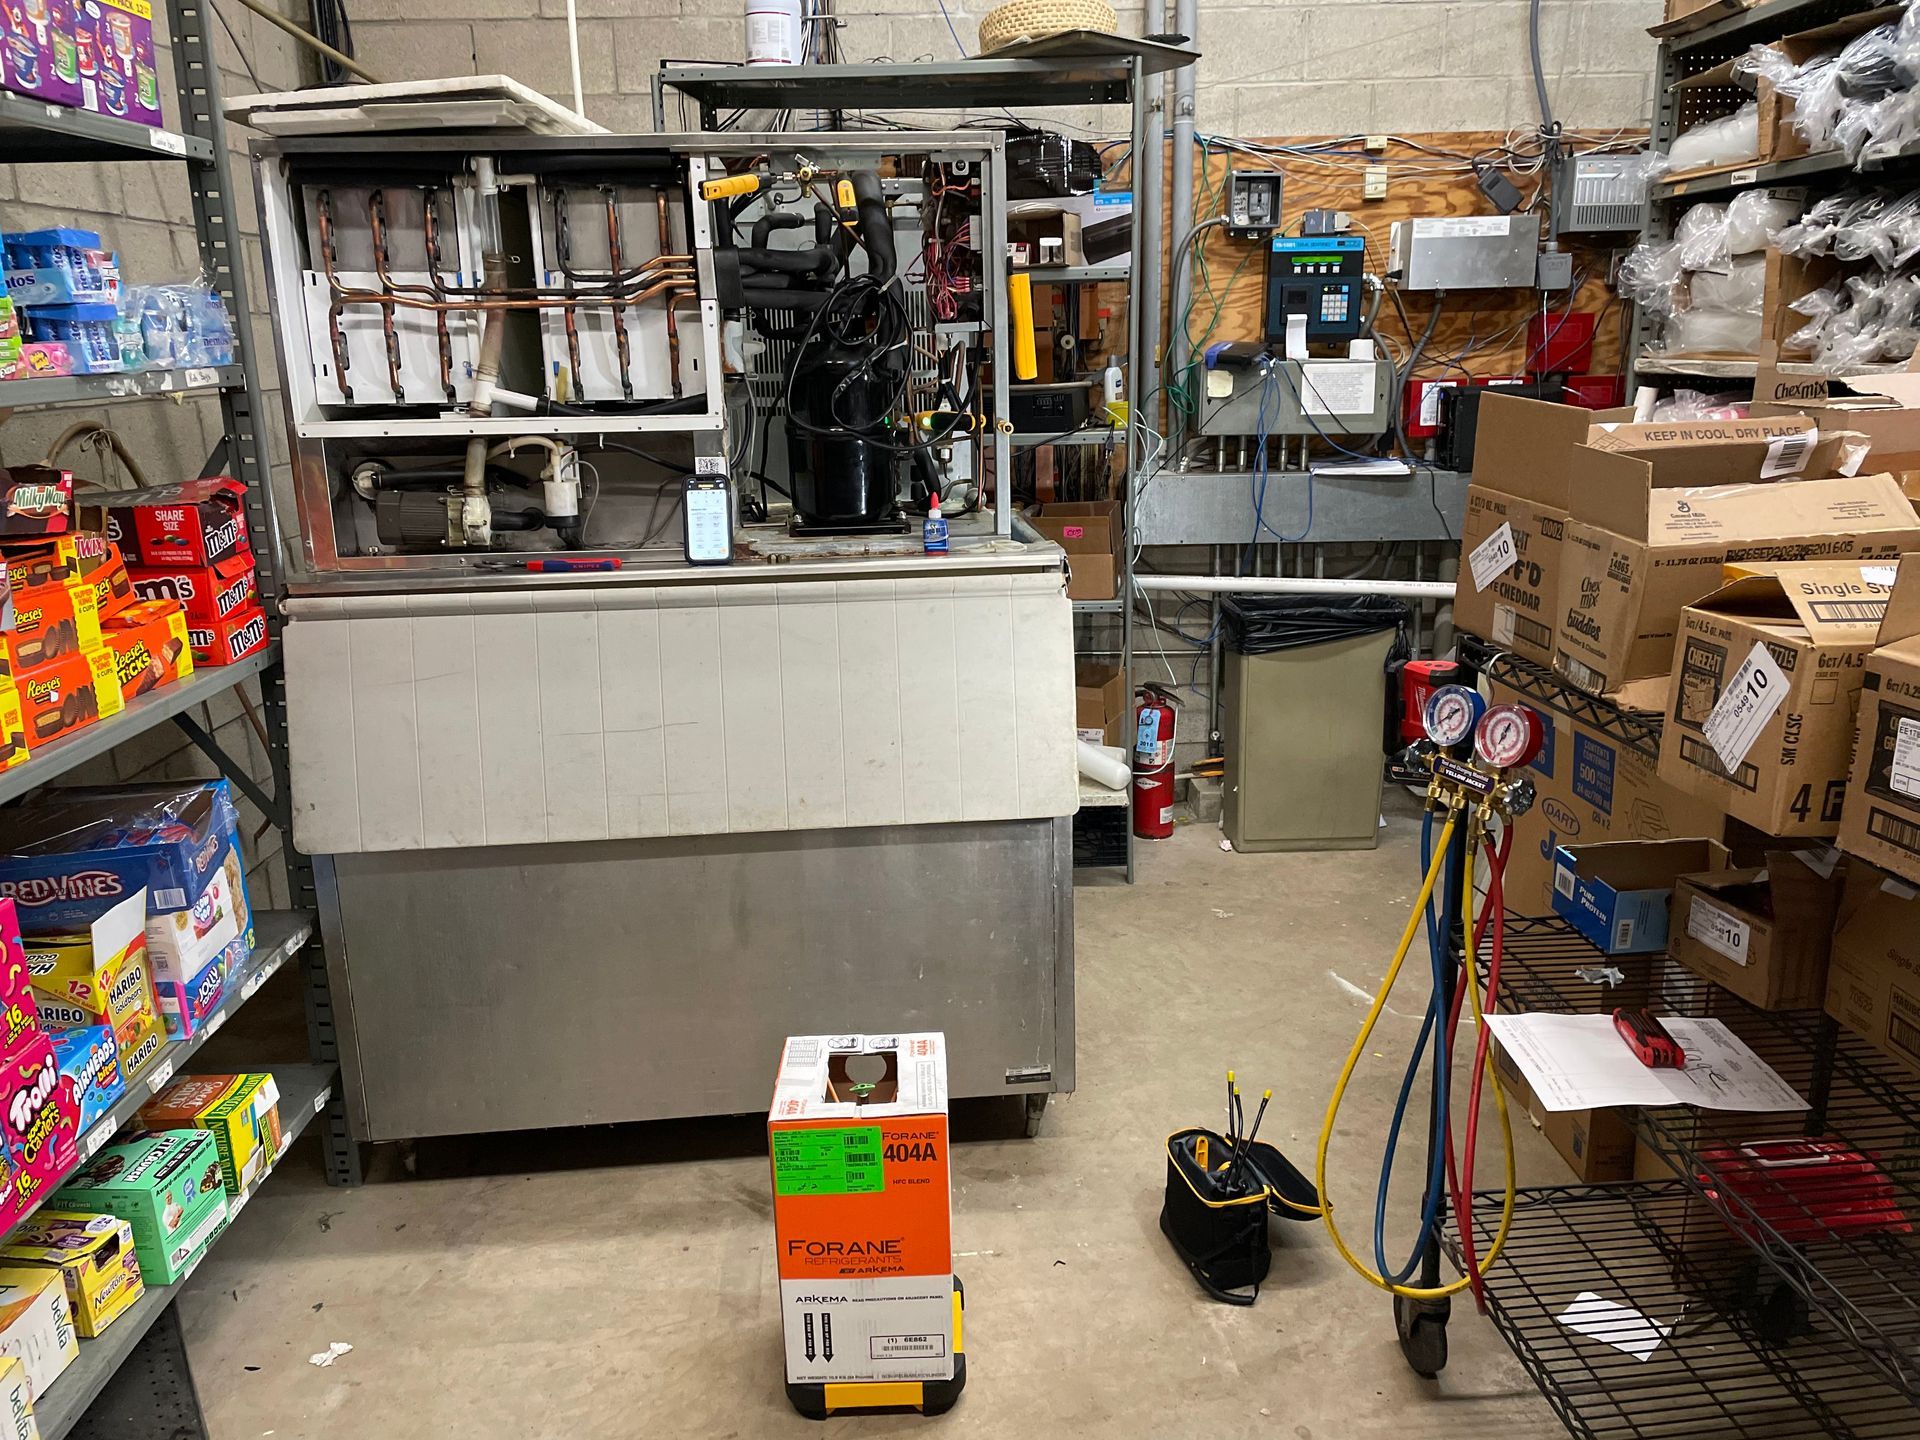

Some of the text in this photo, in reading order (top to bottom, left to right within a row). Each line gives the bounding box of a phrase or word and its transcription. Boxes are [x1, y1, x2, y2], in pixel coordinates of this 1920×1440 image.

[1775, 382, 1800, 400] Chex
[1645, 426, 1802, 442] KEEP IN COOL, DRY PLACE
[155, 510, 185, 521] SHARE
[163, 521, 180, 531] SIZE
[1497, 540, 1509, 558] 10
[1609, 559, 1630, 574] 14865
[74, 588, 94, 599] SUPER
[1500, 582, 1541, 612] CHEDDAR
[1800, 583, 1861, 597] Single
[77, 596, 94, 606] KING
[83, 604, 95, 613] CUPS
[1567, 608, 1601, 642] buddies
[91, 651, 112, 665] SUPER
[96, 660, 111, 671] KING
[101, 668, 114, 678] CUPS
[26, 676, 61, 699] Reese's
[1747, 669, 1768, 699] 10
[1445, 769, 1486, 789] YELLOW JACKET
[1579, 765, 1596, 785] 500
[1790, 784, 1812, 822] 4
[1545, 804, 1576, 830] DART
[1579, 886, 1596, 902] PURE
[1581, 897, 1607, 922] PROTEIN
[1725, 928, 1741, 948] 10
[69, 979, 92, 1000] 12
[99, 970, 110, 991] 12
[108, 966, 142, 1005] HARIBO
[199, 966, 219, 999] JOLLY
[81, 1002, 97, 1011] BAGS
[115, 985, 143, 1015] Goldbears
[6, 1003, 23, 1026] 16
[36, 1007, 85, 1022] ARIBO
[126, 1033, 158, 1075] HARIBO
[73, 1037, 115, 1106] AIRHEADS
[97, 1059, 117, 1083] bites
[10, 1054, 57, 1132] Trolli
[24, 1108, 60, 1164] Crawlers
[208, 1121, 229, 1156] NATURE
[882, 1131, 937, 1141] FORANE
[883, 1142, 937, 1163] 404A
[15, 1169, 32, 1193] 16
[155, 1162, 191, 1197] Award-winning
[190, 1147, 207, 1165] Protein
[788, 1239, 902, 1257] FORANE
[804, 1256, 902, 1266] REFRIGERANTS
[857, 1265, 905, 1274] ARKEMA
[94, 1272, 127, 1310] Newtons
[795, 1294, 849, 1305] ARKEMA
[51, 1293, 72, 1351] belVita
